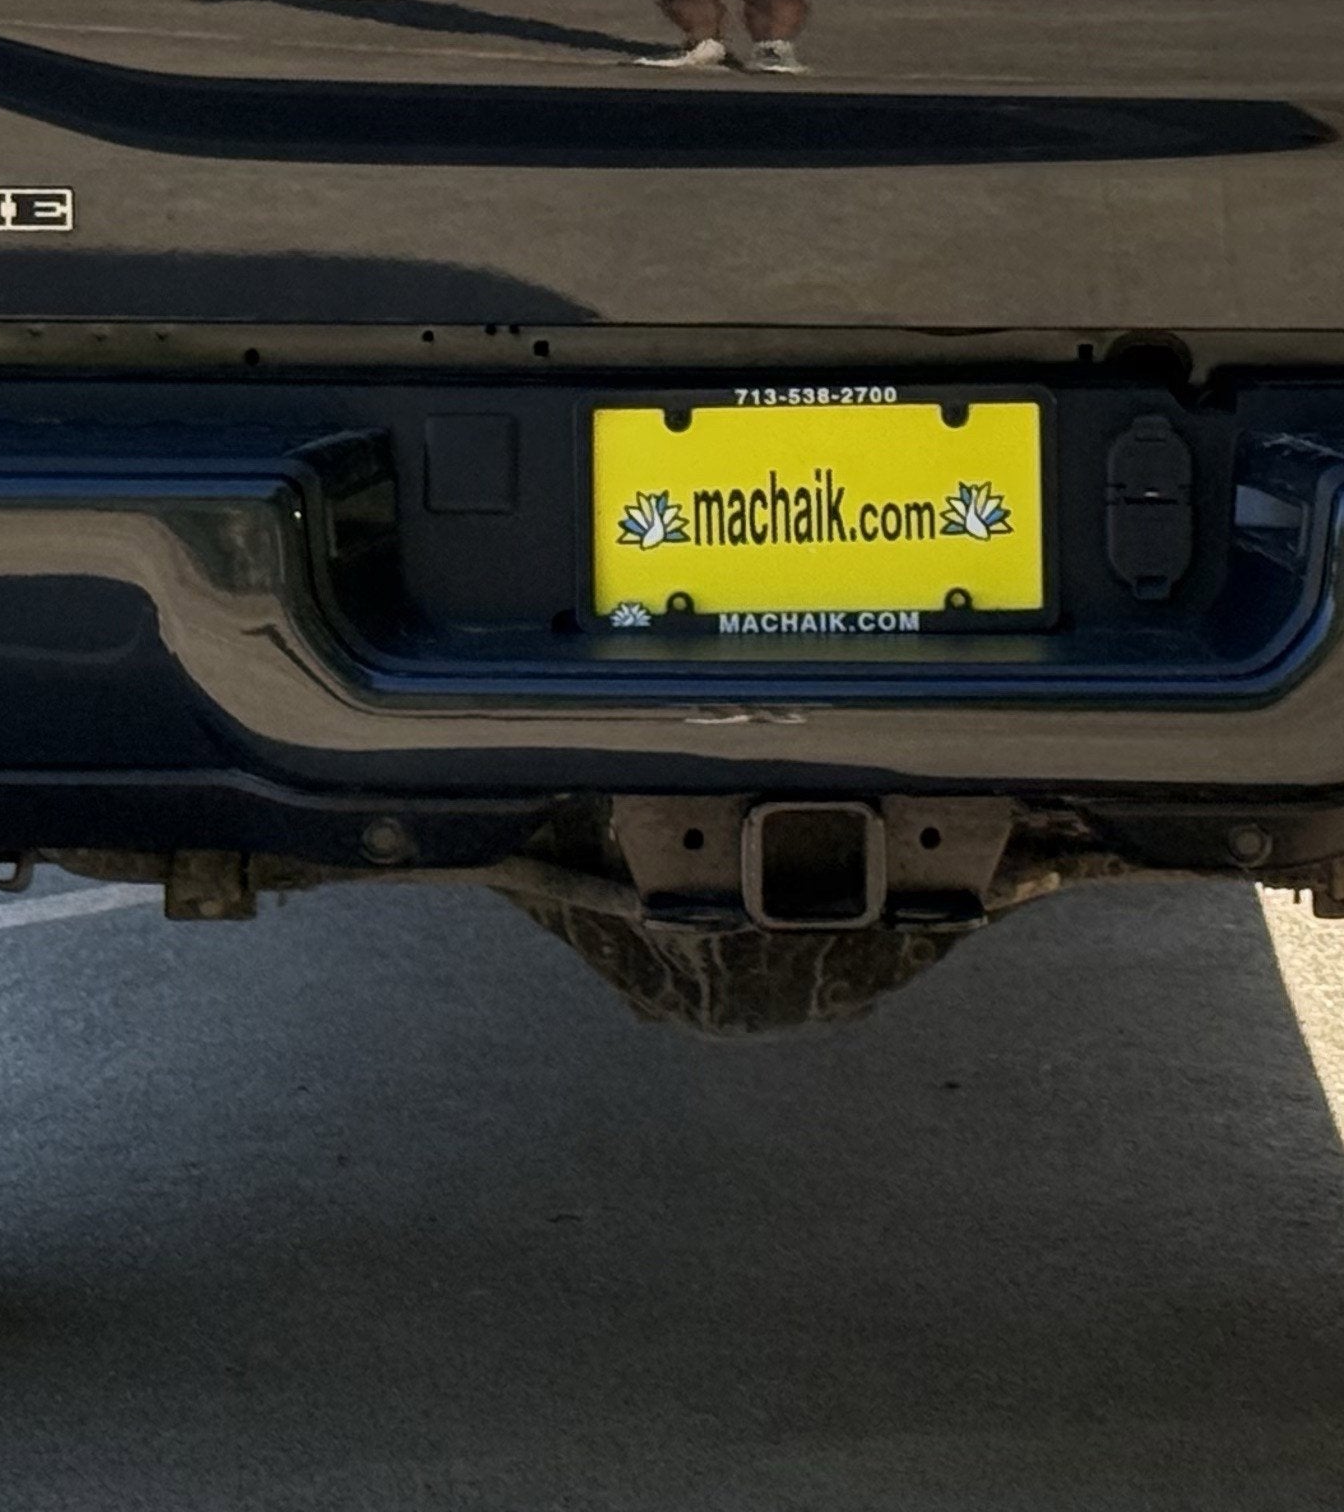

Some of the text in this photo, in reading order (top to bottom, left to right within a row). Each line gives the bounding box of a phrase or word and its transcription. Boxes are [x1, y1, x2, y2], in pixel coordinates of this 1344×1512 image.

[733, 386, 898, 406] 713-538-2700
[693, 467, 936, 547] machaik.com
[718, 610, 921, 635] MACHAIK.COM
